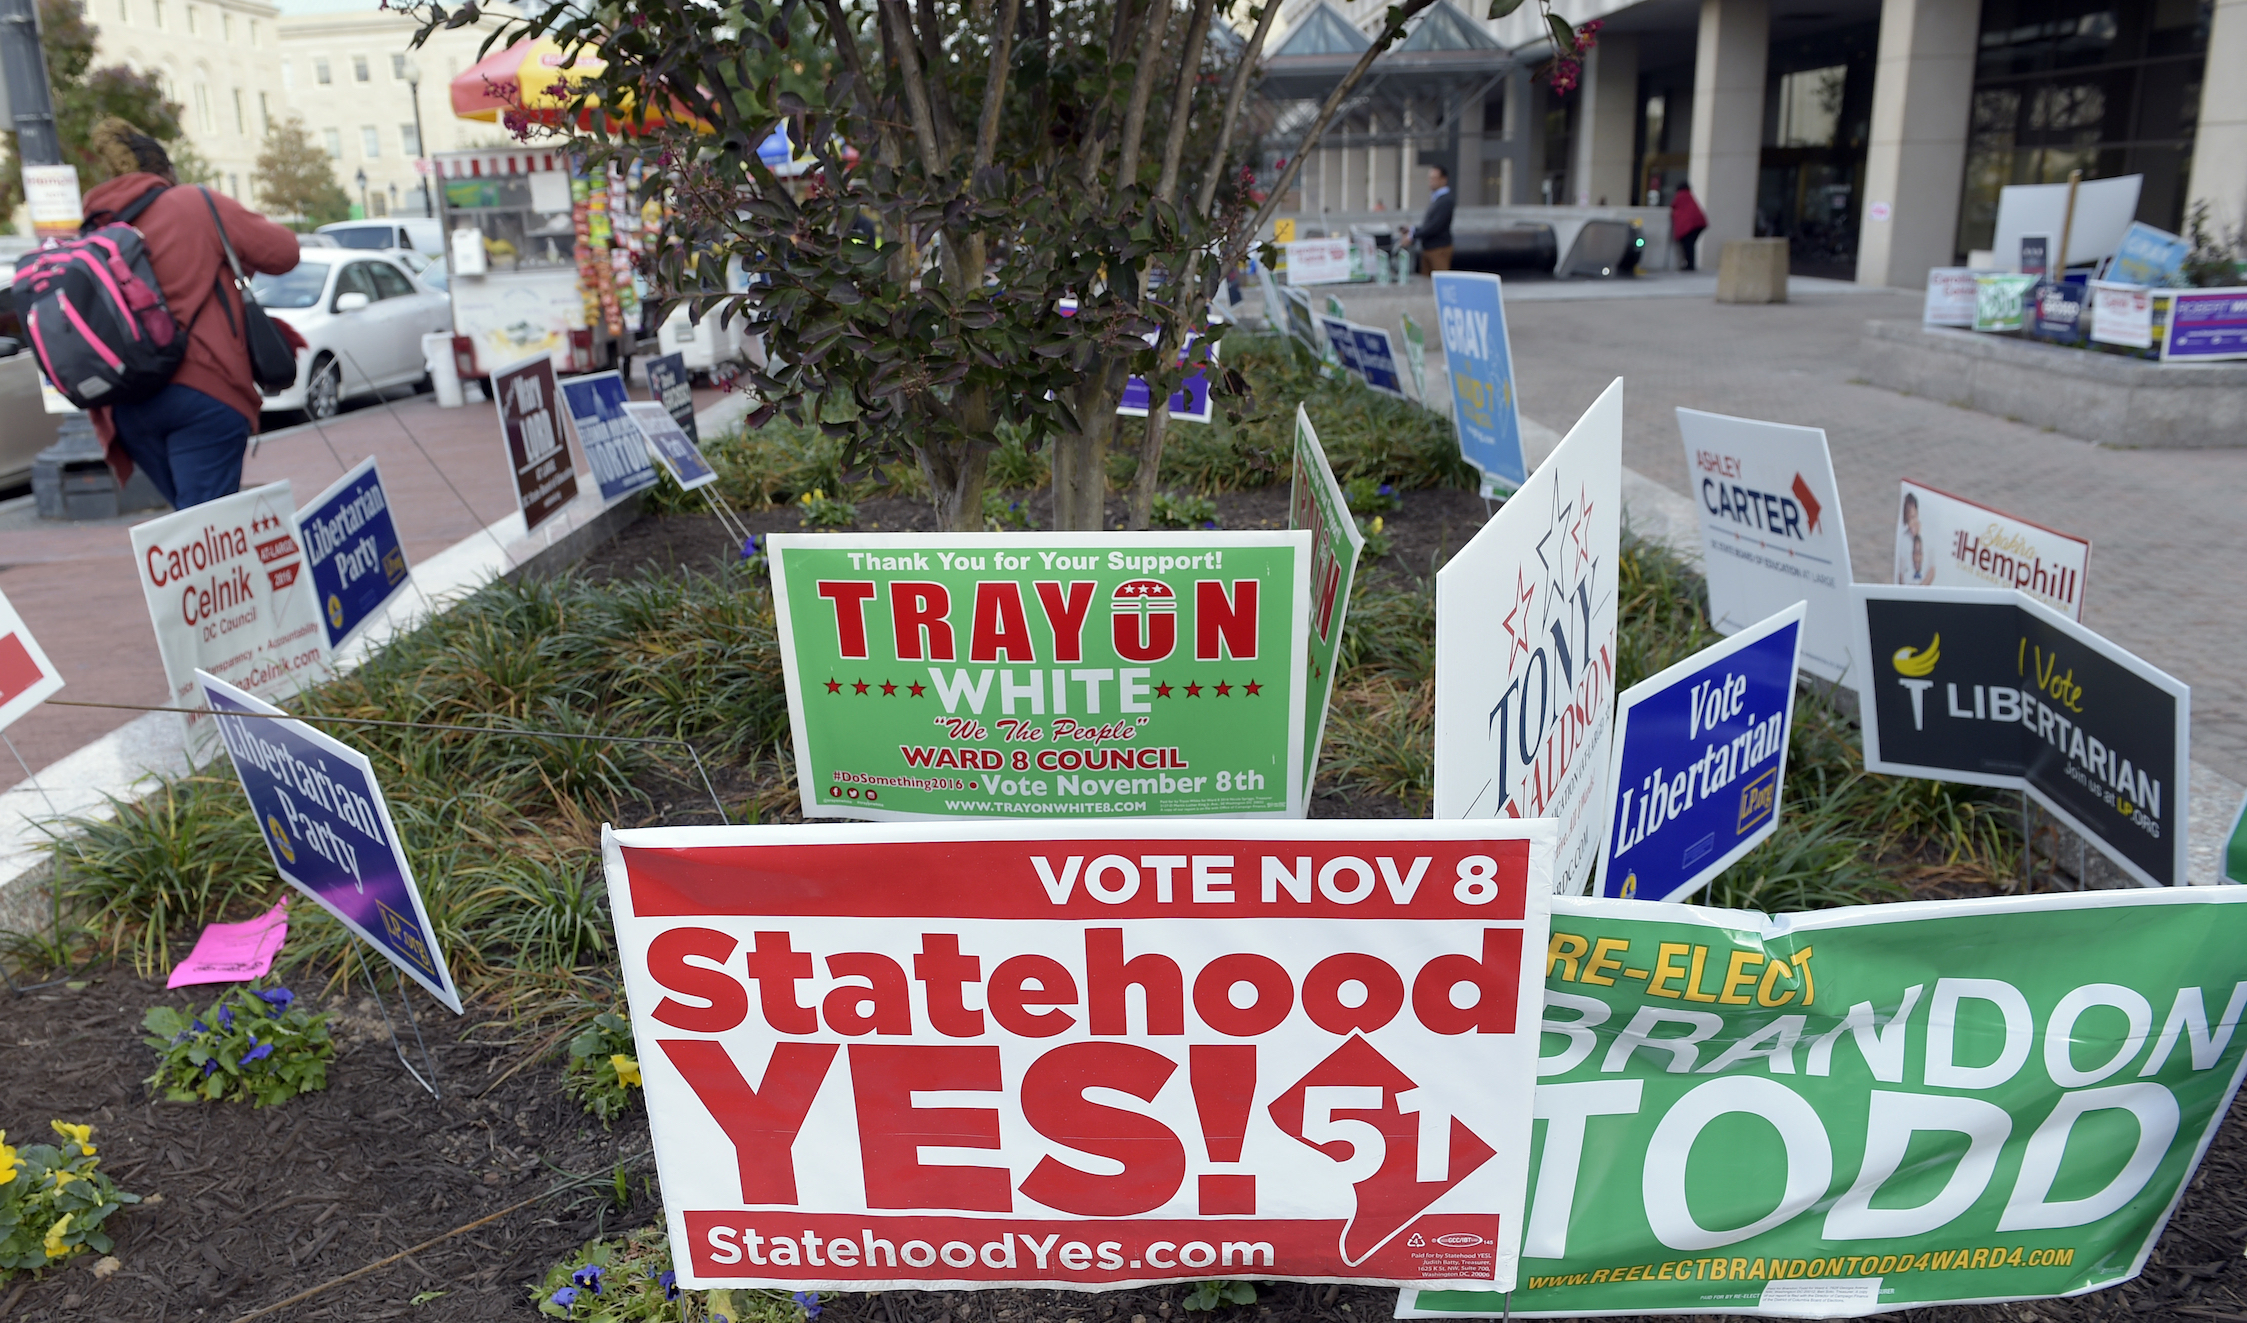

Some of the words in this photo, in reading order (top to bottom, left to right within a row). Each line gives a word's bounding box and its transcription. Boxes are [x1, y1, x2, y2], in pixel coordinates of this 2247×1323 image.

[1441, 304, 1490, 361] GRAY
[1696, 450, 1741, 480] ASHLEY
[303, 484, 386, 568] Libertarian
[1703, 477, 1804, 541] CARTER
[146, 524, 249, 588] Carolina
[260, 538, 296, 562] AT-LARGE
[273, 569, 293, 587] 2016
[334, 534, 381, 592] Party
[846, 551, 930, 572] Thank
[936, 551, 988, 572] You
[993, 550, 1032, 571] for
[1037, 550, 1100, 571] Your
[1106, 550, 1224, 575] Support!
[1764, 558, 1802, 579] EDUCATION
[1956, 529, 2077, 604] Hemphill
[181, 564, 255, 627] Celnik
[202, 621, 218, 644] DC
[219, 606, 258, 637] Council
[815, 578, 1261, 664] TRAYON
[266, 621, 320, 650] Accountability
[927, 666, 1153, 716] WHITE
[1489, 555, 1600, 818] TONY
[1689, 671, 1748, 742] Vote
[2017, 636, 2028, 677] I
[2034, 644, 2084, 714] Vote
[898, 745, 1004, 771] WARD
[1011, 745, 1030, 771] 8
[1035, 745, 1190, 771] COUNCIL
[996, 717, 1046, 743] The
[1946, 681, 2161, 820] LIBERTARIAN
[213, 701, 387, 848] Libertarian
[832, 769, 965, 792] #DoSomething2016
[980, 773, 1048, 797] Vote
[1056, 772, 1207, 797] November
[1215, 769, 1265, 792] 8th
[1613, 710, 1783, 860] Libertarian
[1741, 780, 1774, 820] LP.org
[2063, 760, 2088, 787] Join
[2087, 780, 2103, 798] us
[2102, 790, 2117, 808] at
[2116, 796, 2161, 839] LP.ORG
[944, 800, 1147, 814] WWW.TRAYONWHITE8.COM
[273, 785, 364, 896] Party
[1029, 854, 1236, 905] VOTE
[1260, 855, 1434, 906] NOV
[1451, 854, 1500, 906] 8
[646, 926, 1525, 1039] Statehood
[1545, 931, 1815, 1007] RE-ELECT
[1536, 977, 2247, 1090] BRANDON
[655, 1038, 1258, 1218] YES!
[1300, 1084, 1451, 1186] 51
[1521, 1073, 2182, 1260] TODD
[707, 1224, 1276, 1270] StatehoodYes.com
